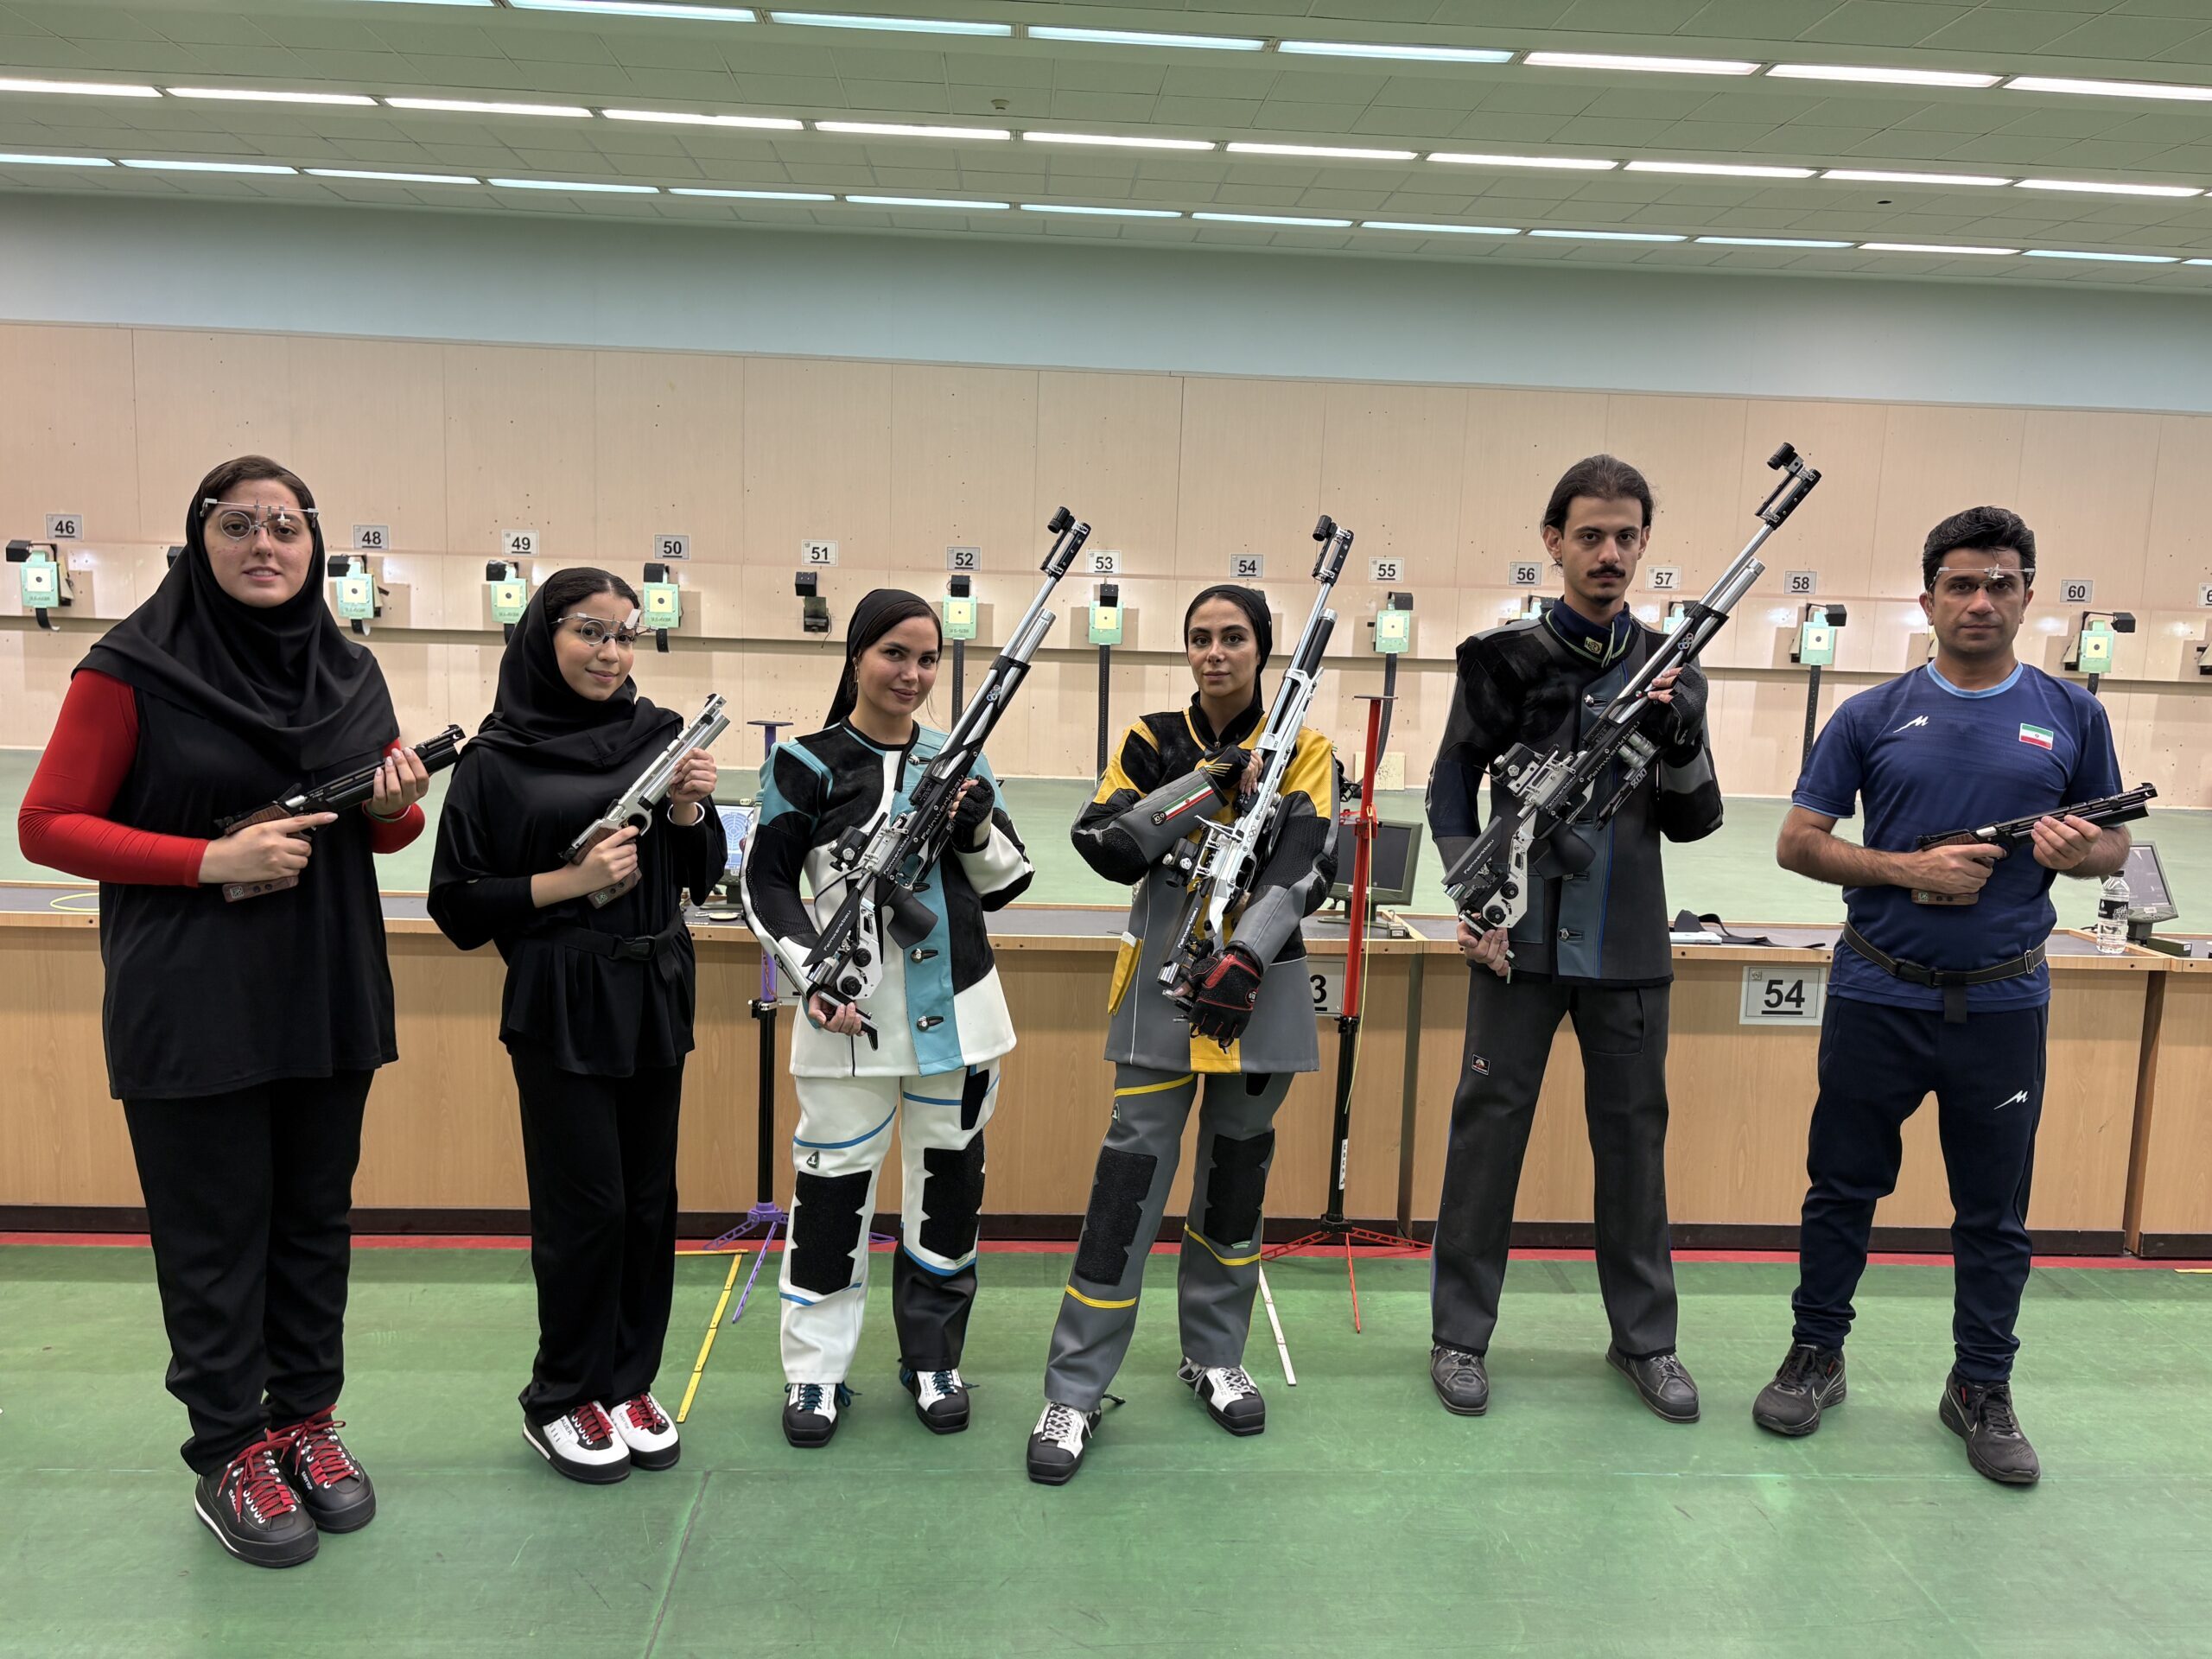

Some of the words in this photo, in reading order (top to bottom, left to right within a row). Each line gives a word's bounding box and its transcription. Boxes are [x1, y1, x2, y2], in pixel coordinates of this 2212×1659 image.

[55, 520, 75, 535] 46
[362, 531, 382, 545] 48
[512, 537, 531, 550] 49
[663, 541, 682, 555] 50
[811, 547, 829, 560] 51
[955, 552, 974, 566] 52
[1096, 556, 1113, 569] 53
[1238, 560, 1257, 574] 54
[1378, 563, 1395, 577] 55
[1517, 568, 1535, 581] 56
[1656, 572, 1673, 585] 57
[1792, 576, 1809, 589] 58
[2068, 585, 2086, 599] 60
[2206, 589, 2212, 602] 6
[1587, 721, 1641, 781] Feinwerkbau
[1630, 767, 1648, 789] 800
[920, 774, 965, 841] Feinwerkbau
[1309, 974, 1327, 1004] 3
[1764, 979, 1806, 1008] 54
[561, 1417, 573, 1436] AUER
[228, 1488, 238, 1513] SAU
